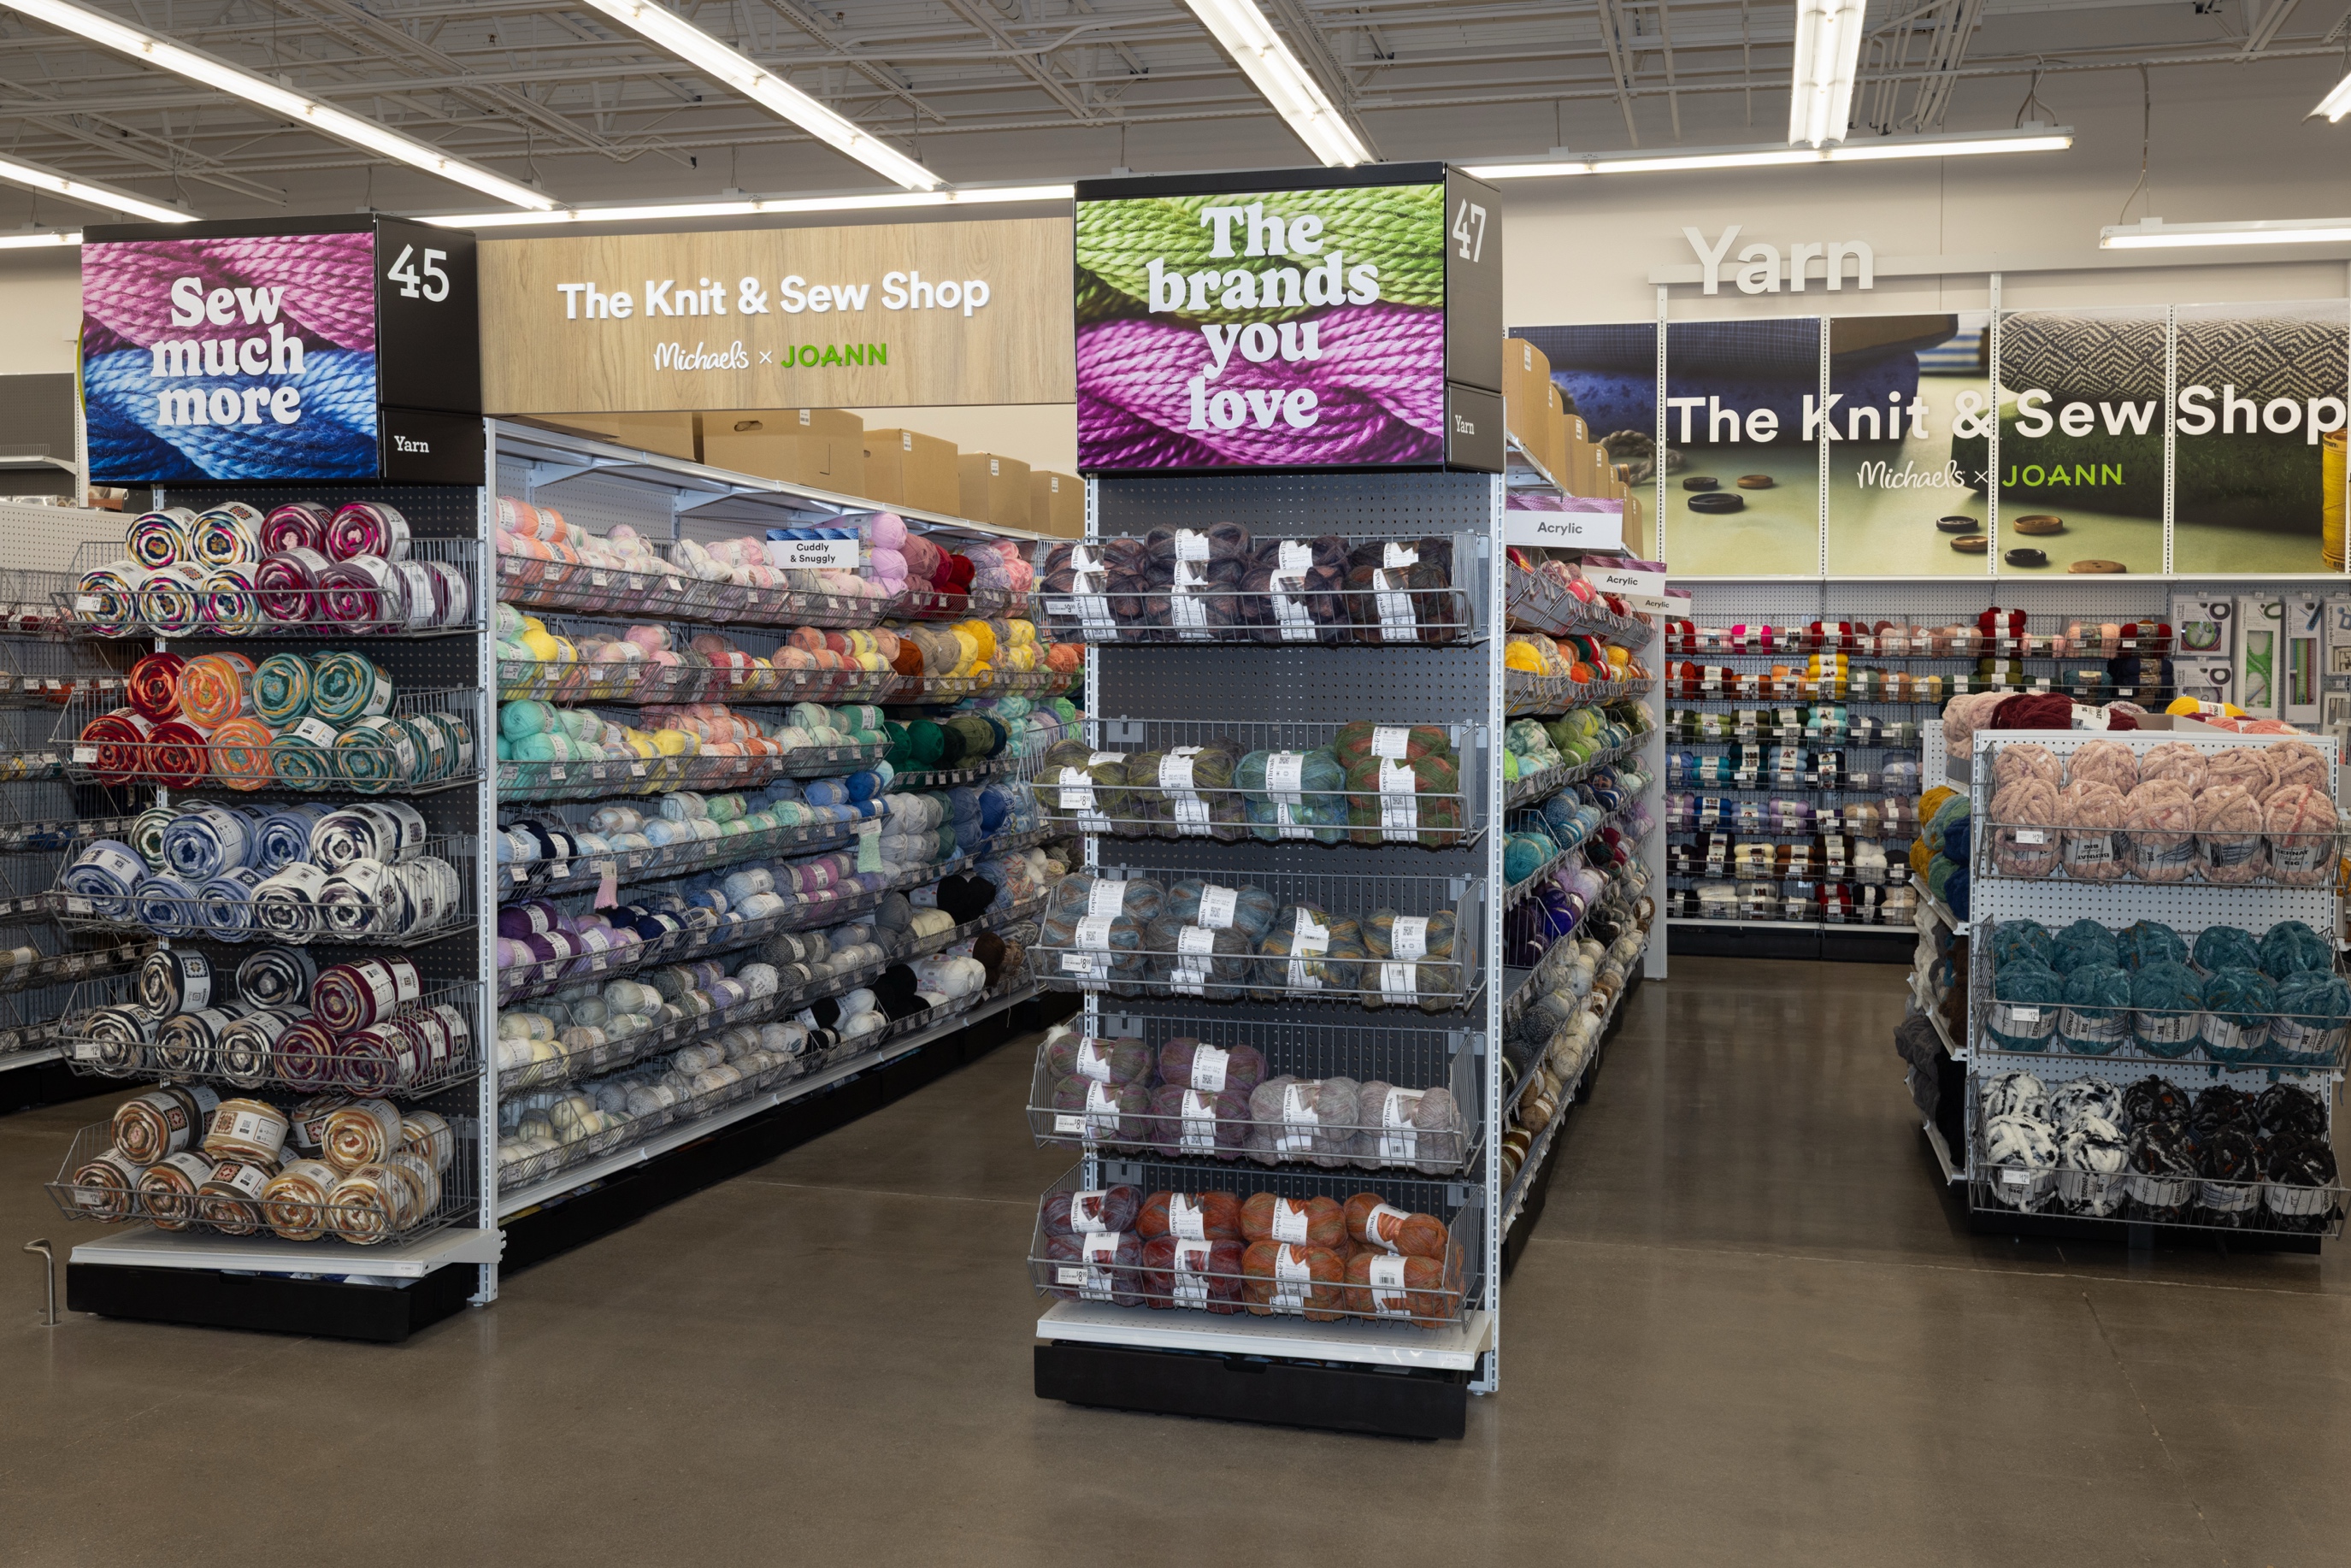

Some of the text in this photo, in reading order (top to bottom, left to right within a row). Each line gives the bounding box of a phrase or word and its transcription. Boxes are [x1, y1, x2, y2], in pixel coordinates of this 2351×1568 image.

[1200, 201, 1324, 258] The
[1452, 197, 1487, 263] 47
[1682, 225, 1875, 296] Yarn
[387, 244, 450, 302] 45
[1146, 250, 1380, 314] brands
[170, 276, 285, 327] Sew
[557, 271, 991, 320] The Knit & Sew Shop
[150, 322, 307, 377] much
[653, 340, 750, 371] Michaels
[781, 343, 887, 368] JOANN
[1201, 320, 1323, 380] you
[156, 385, 302, 427] more
[1187, 374, 1319, 431] love
[1667, 384, 2348, 445] The Knit & Sew Shop
[1454, 414, 1476, 437] Yarn
[394, 434, 429, 454] Yarn
[1857, 459, 1966, 490] Michaels
[2001, 463, 2123, 487] JOANN
[1537, 522, 1583, 536] Acrylic
[790, 553, 836, 564] & Snuggly
[796, 543, 829, 554] Cuddly
[1606, 575, 1639, 587] Acrylic
[1645, 599, 1670, 610] Acrylic
[1266, 757, 1276, 781] Threads
[2065, 1011, 2075, 1036] BERNAT
[2080, 1023, 2089, 1034] BIG
[1078, 1040, 1088, 1062] Threads
[2314, 1030, 2329, 1052] BERNAT
[1193, 1053, 1204, 1070] Loops
[1283, 1088, 1293, 1112] Threads
[1383, 1097, 1394, 1121] Threads
[2080, 1177, 2089, 1198] BERNAT
[2173, 1182, 2183, 1204] BERNAT
[1071, 1201, 1080, 1223] Threads
[1170, 1217, 1179, 1235] Loops
[1274, 1219, 1282, 1238] Loops
